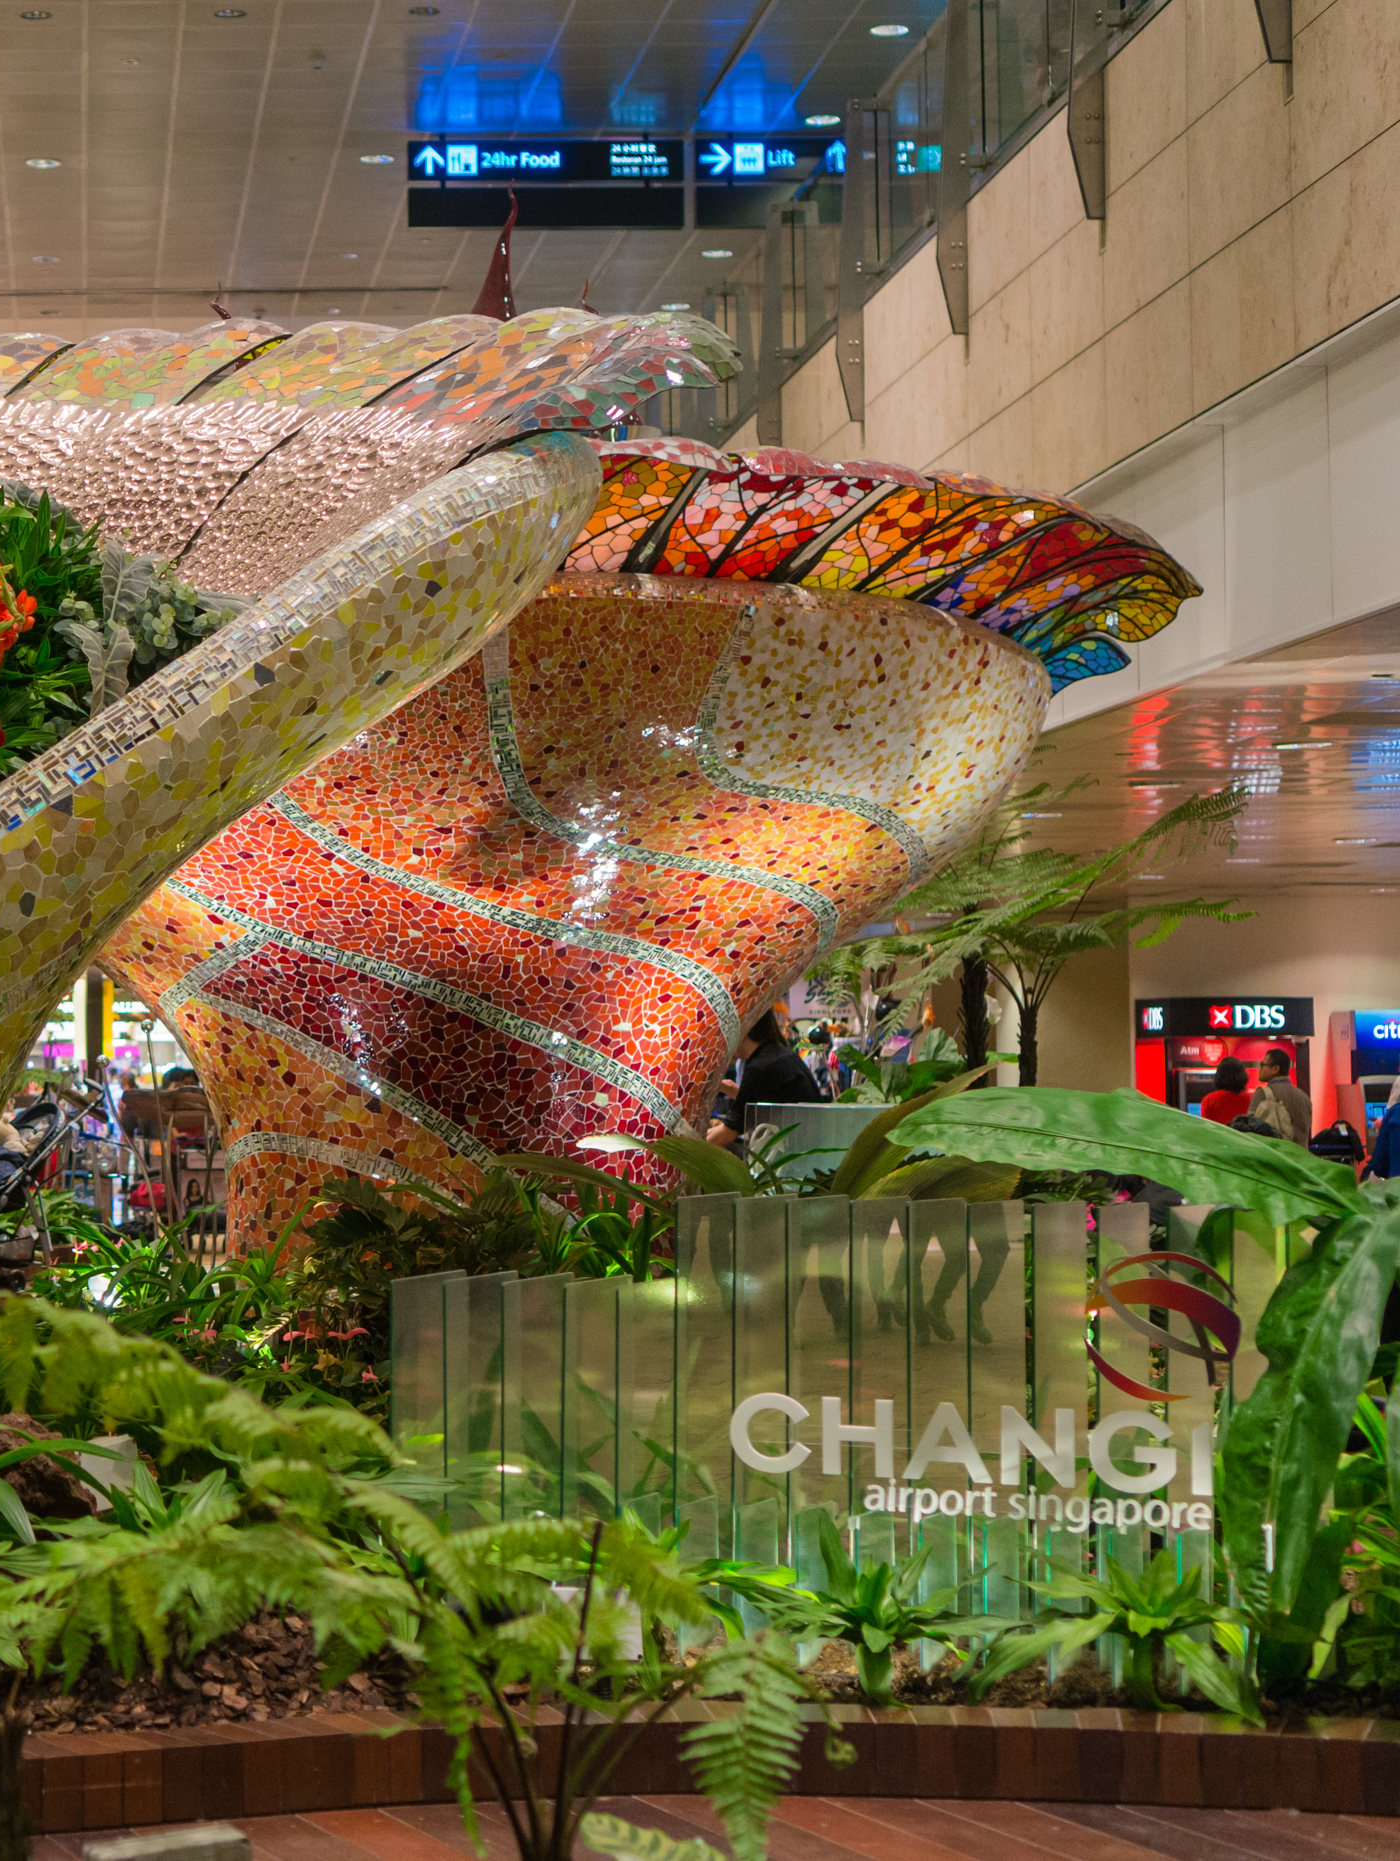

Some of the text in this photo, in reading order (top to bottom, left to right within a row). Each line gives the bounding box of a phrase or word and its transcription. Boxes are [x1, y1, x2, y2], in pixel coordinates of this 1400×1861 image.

[481, 150, 561, 168] 24hr Food
[643, 155, 653, 165] 24
[767, 149, 796, 167] Lift
[1149, 1006, 1164, 1030] DBS
[1234, 1004, 1286, 1029] DBS
[1181, 1046, 1200, 1055] Atm
[730, 1393, 1213, 1496] CHANGI
[863, 1478, 1213, 1534] airport singapore
